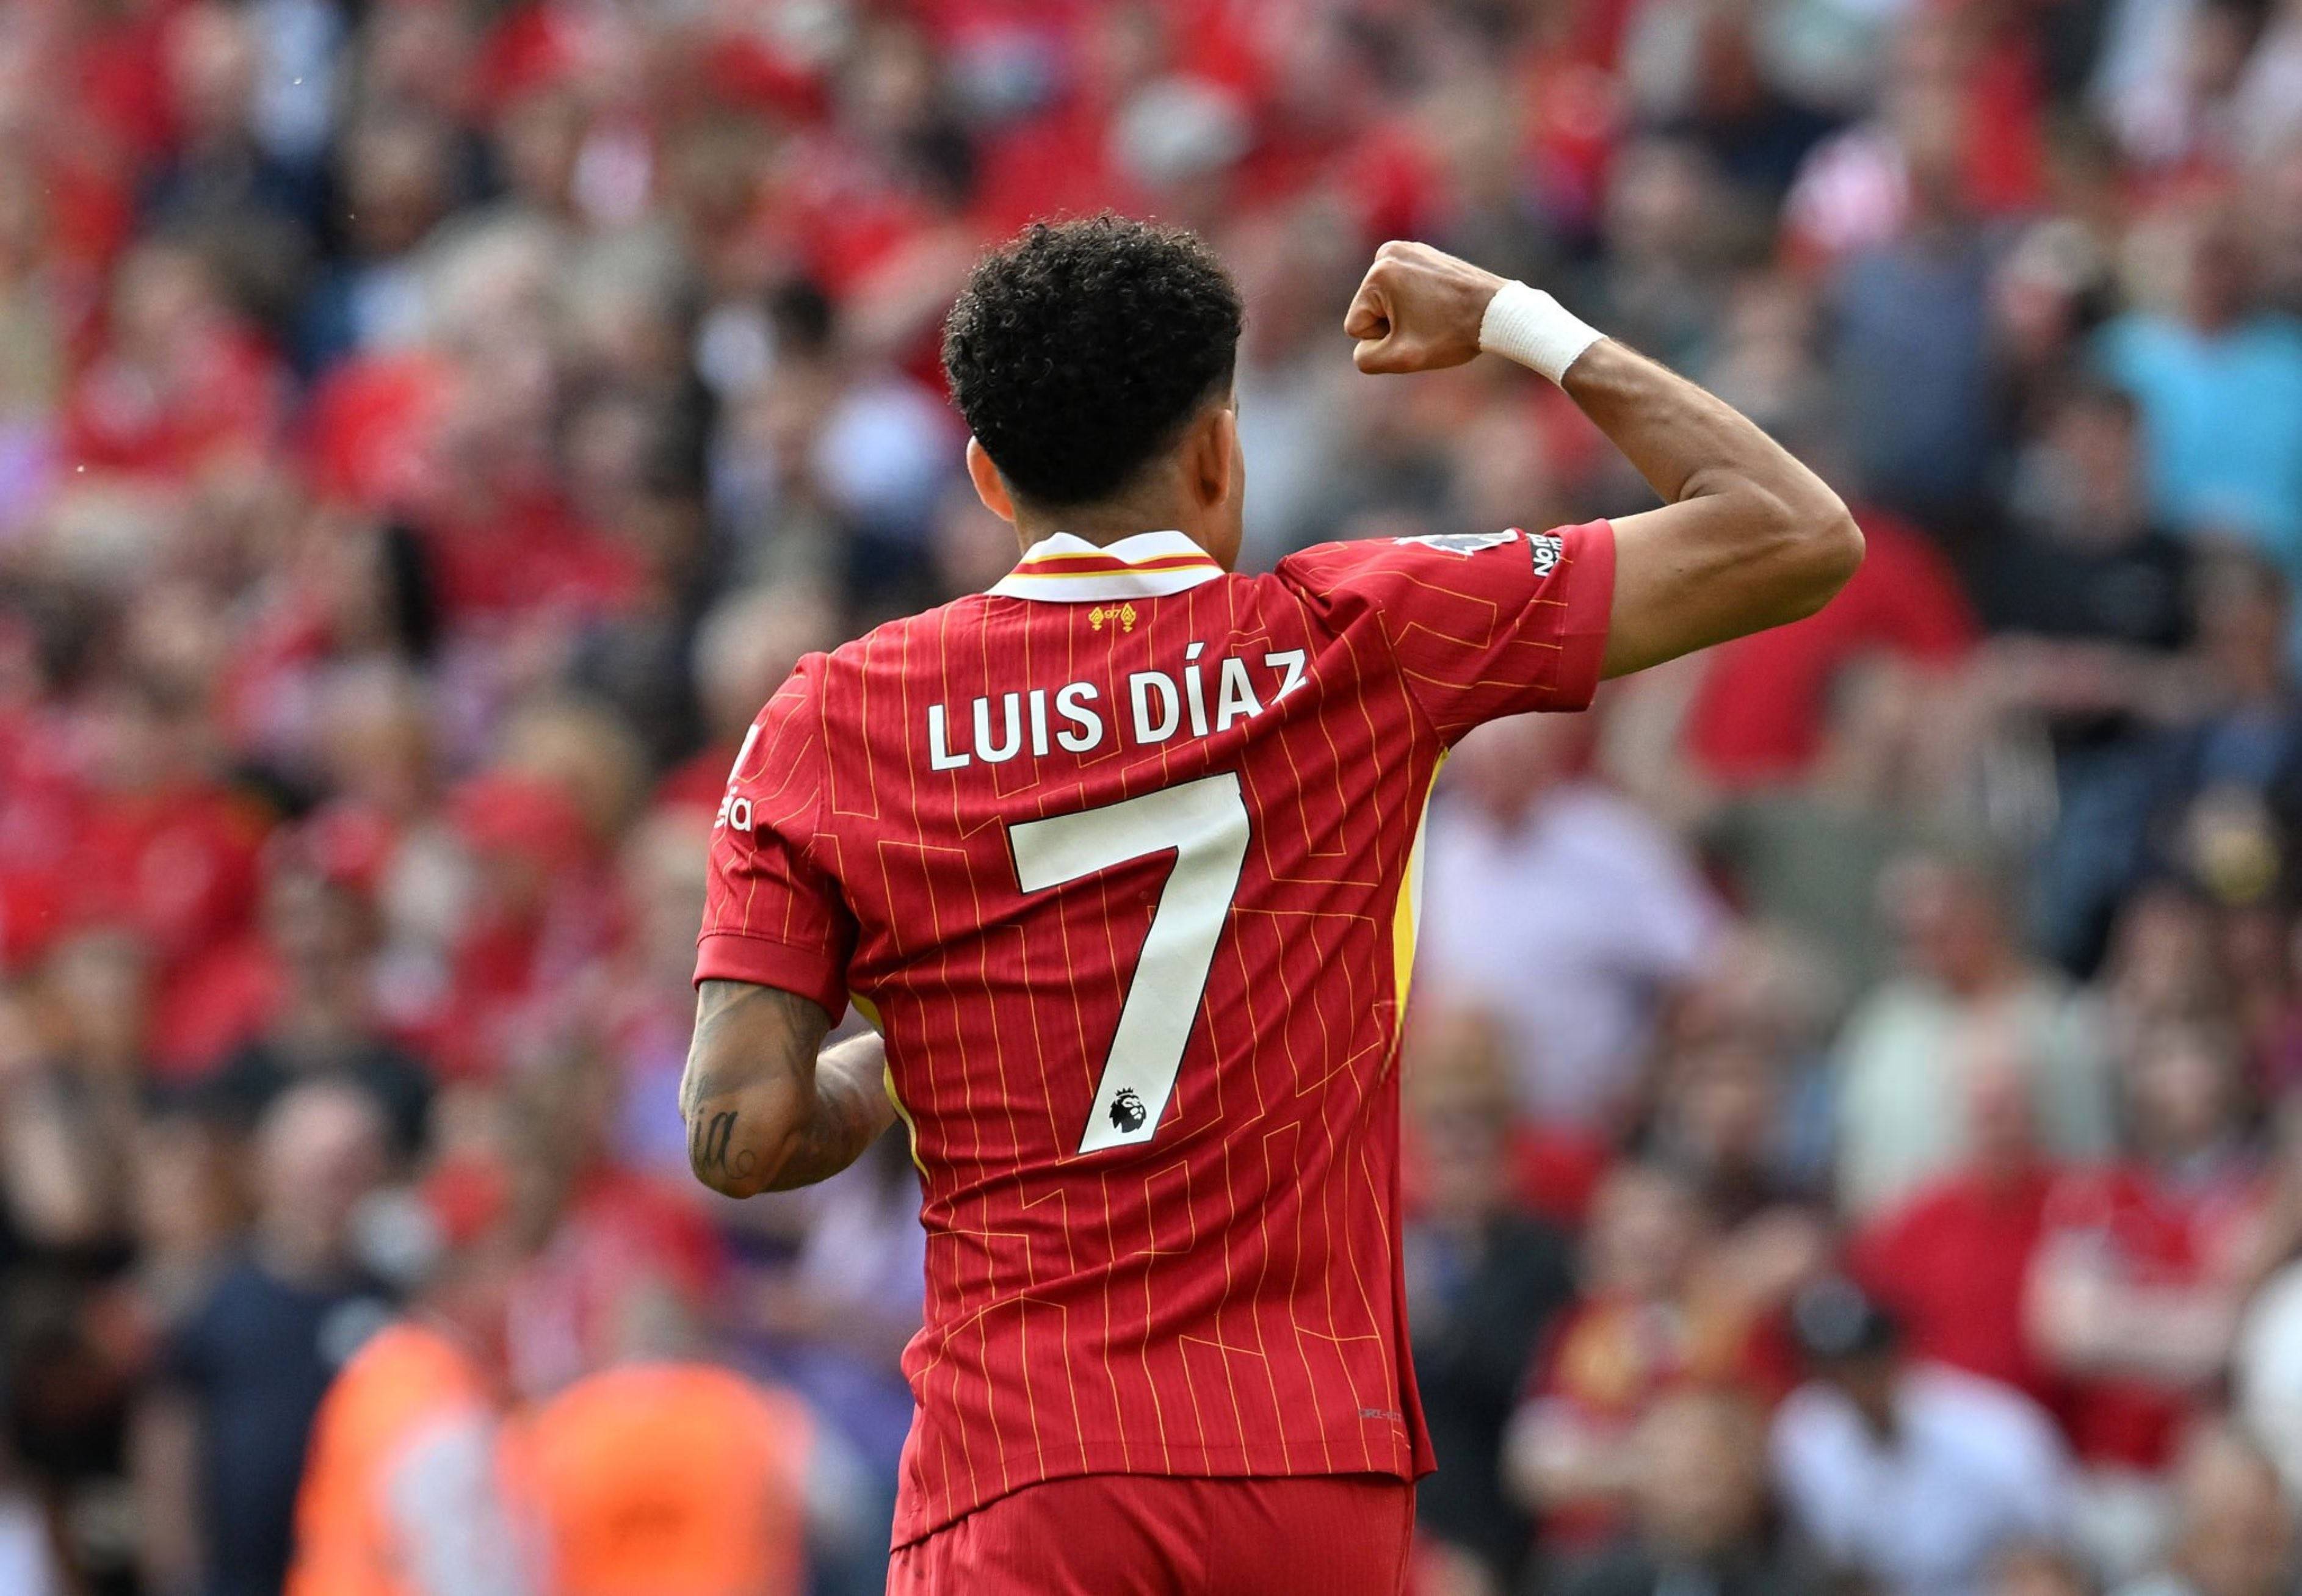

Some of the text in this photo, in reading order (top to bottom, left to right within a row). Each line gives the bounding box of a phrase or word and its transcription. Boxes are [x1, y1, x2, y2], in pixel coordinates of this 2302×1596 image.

[928, 641, 1309, 771] LUIS DÍAZ
[1008, 770, 1251, 1154] 7
